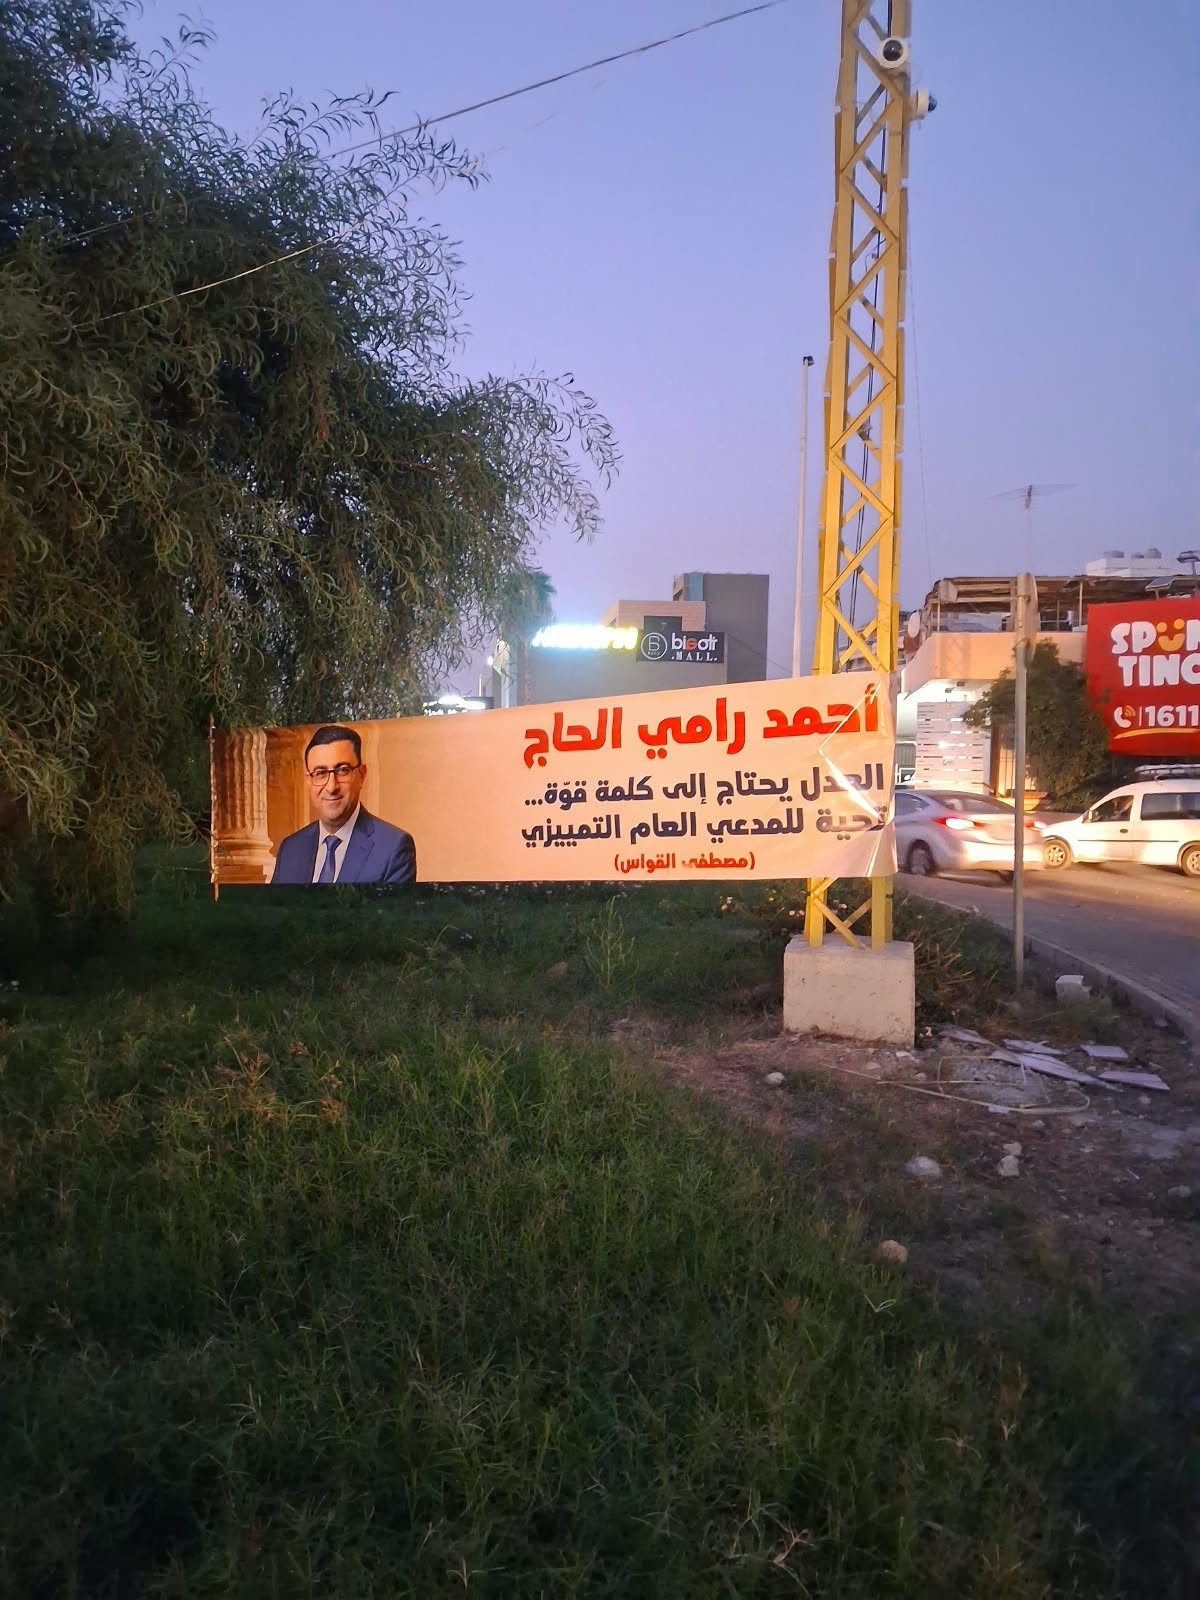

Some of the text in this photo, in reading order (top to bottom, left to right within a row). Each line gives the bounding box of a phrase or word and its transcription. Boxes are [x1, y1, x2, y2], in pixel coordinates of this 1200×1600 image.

[523, 683, 879, 769] أحمد رامي الحاج
[595, 775, 654, 802] كلمة
[662, 772, 707, 805] إلى
[716, 770, 793, 806] يحتاج
[521, 814, 622, 848] التمييزي
[630, 811, 697, 845] العام
[706, 807, 804, 844] للمدعي
